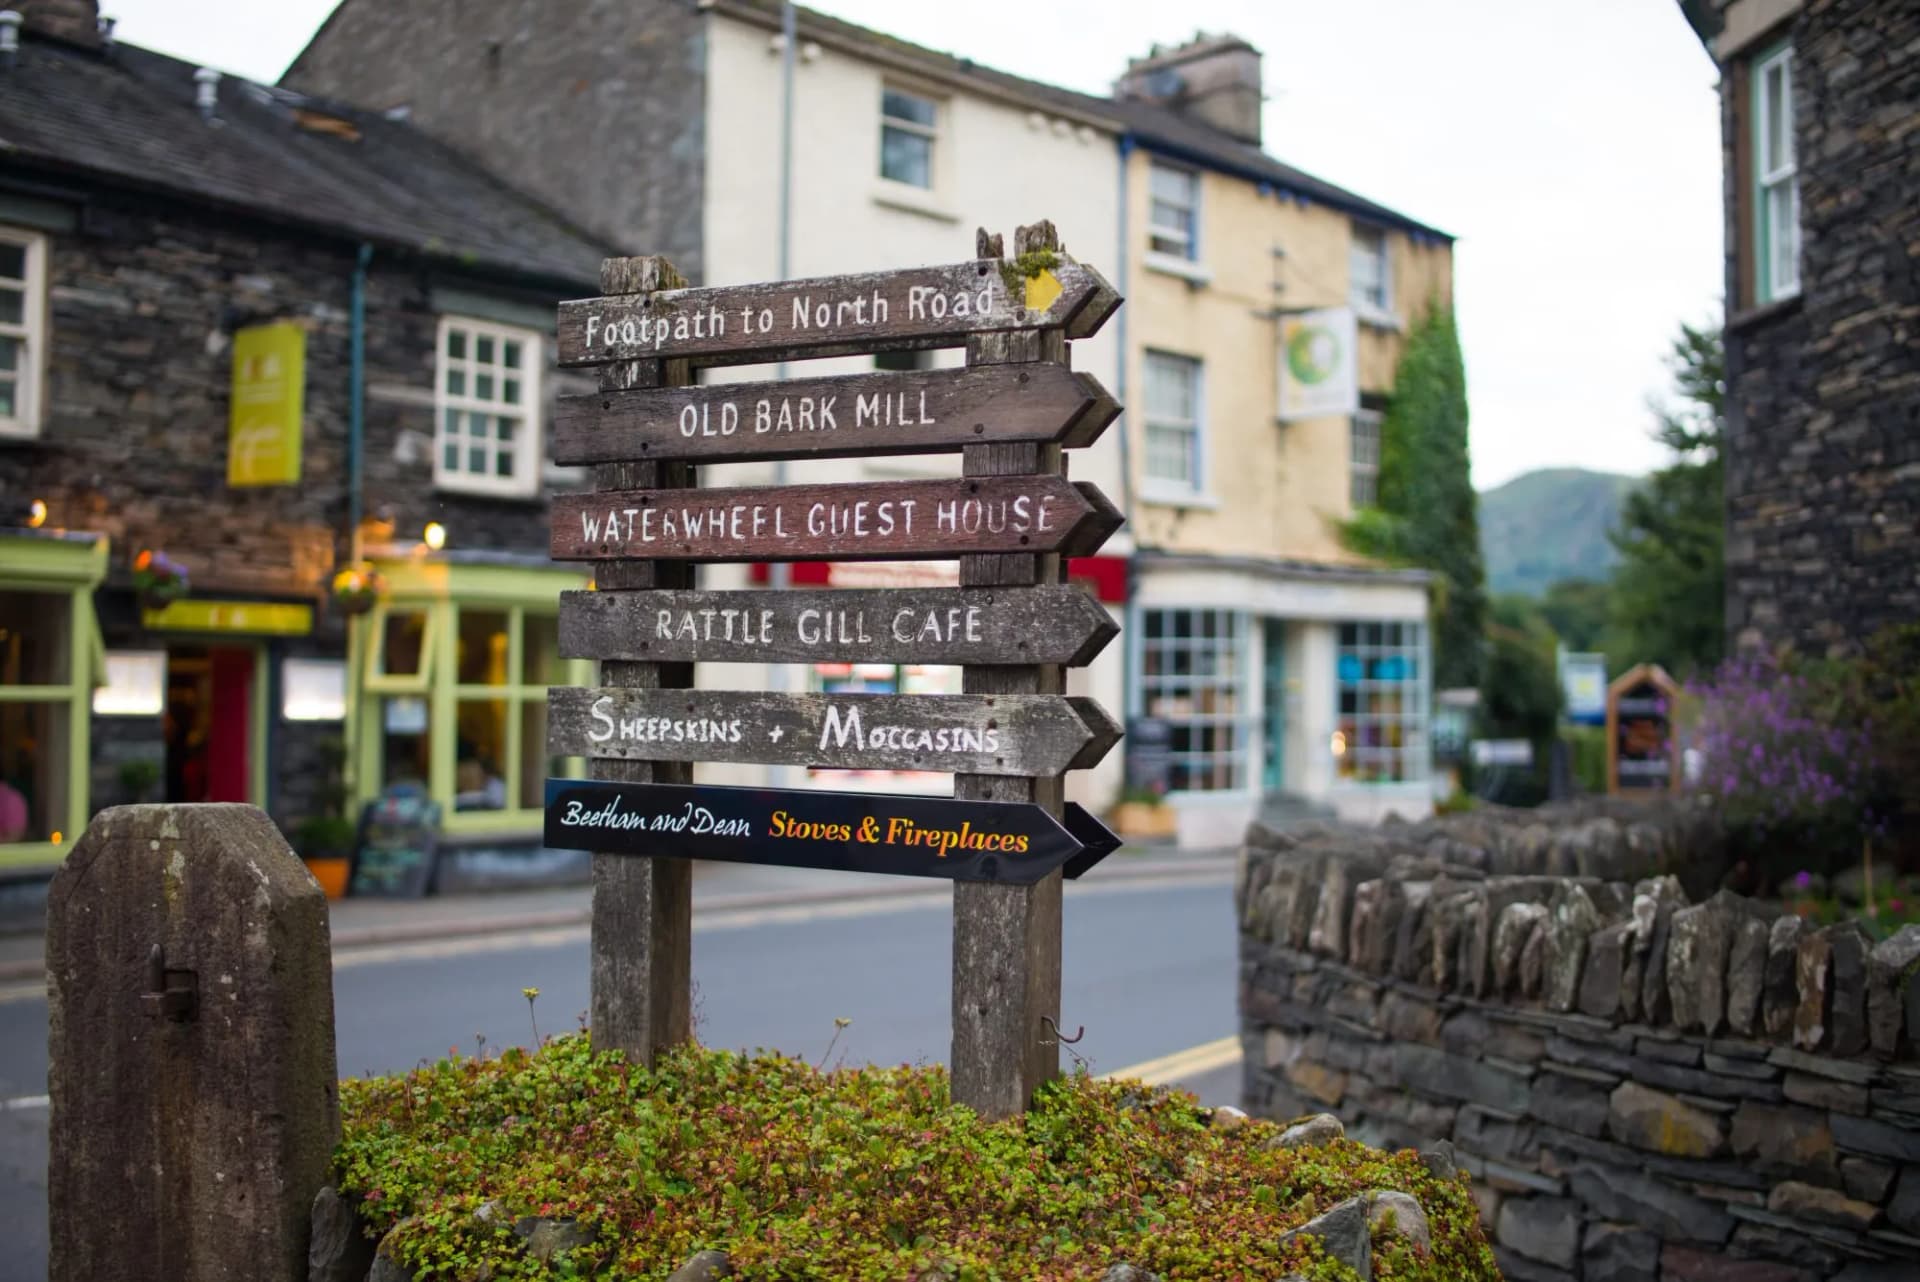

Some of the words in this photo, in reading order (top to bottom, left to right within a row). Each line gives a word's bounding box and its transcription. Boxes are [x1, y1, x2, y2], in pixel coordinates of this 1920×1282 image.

[585, 305, 725, 350] Footpath
[741, 305, 774, 334] to
[791, 289, 888, 330] North
[908, 279, 993, 322] Road
[679, 402, 738, 437] OLD
[755, 396, 837, 434] BARK
[855, 390, 936, 428] MILL
[581, 505, 788, 543] WATERWHEEL
[807, 500, 917, 537] GUEST
[937, 494, 1056, 534] HOUSE
[655, 608, 775, 644] RATTLE
[797, 608, 873, 645] GILL
[560, 794, 647, 831] Beetham
[649, 802, 693, 834] and
[690, 807, 751, 837] Dean
[768, 810, 850, 841] Stoves
[855, 816, 880, 844] &
[884, 817, 1029, 857] Fireplaces
